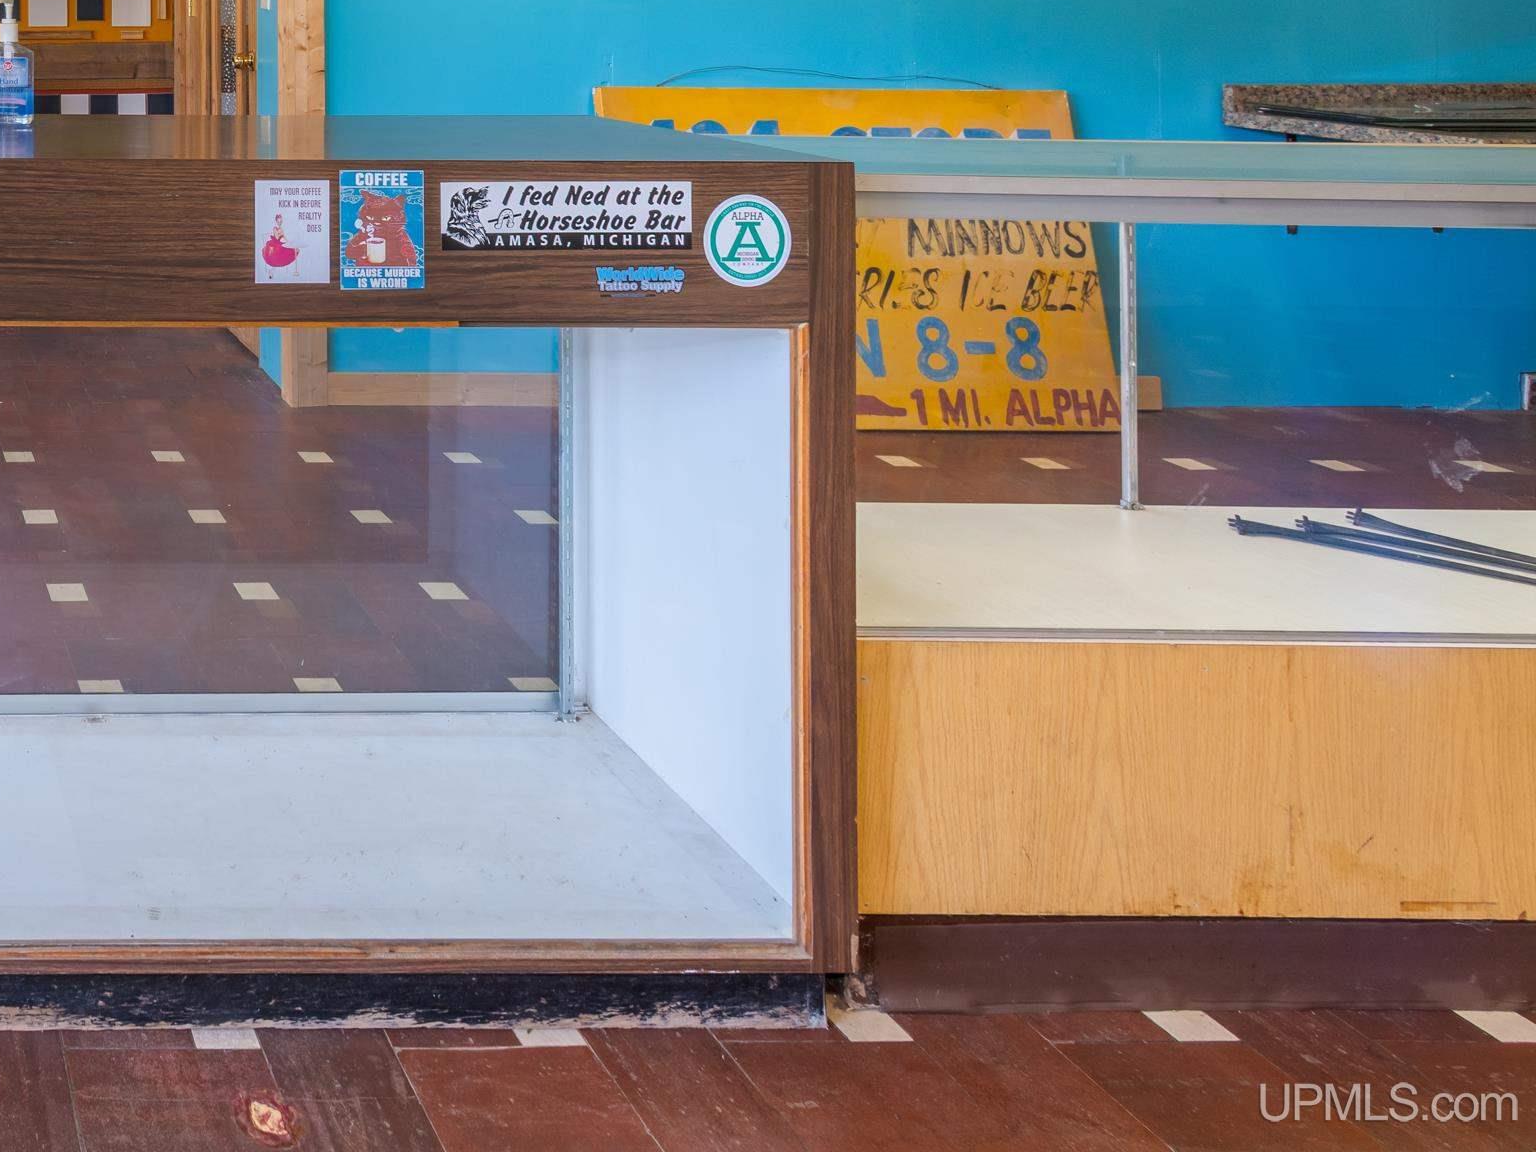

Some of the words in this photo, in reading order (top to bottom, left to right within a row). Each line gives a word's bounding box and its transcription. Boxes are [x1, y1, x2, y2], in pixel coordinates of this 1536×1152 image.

[355, 172, 408, 186] COFFEE
[269, 188, 282, 196] MAY
[284, 188, 300, 196] YOUR
[301, 188, 321, 196] COFFEE
[502, 185, 514, 205] I
[519, 185, 559, 206] fed
[564, 185, 610, 206] Ned
[616, 188, 641, 206] at
[648, 184, 685, 206] the
[279, 200, 291, 208] KICK
[293, 200, 298, 208] IN
[300, 200, 321, 208] BEFORE
[299, 212, 322, 220] REALITY
[519, 210, 636, 231] Horseshoe
[645, 210, 686, 231] Bar
[731, 211, 764, 221] ALPHA
[307, 224, 322, 233] DOES
[494, 235, 572, 247] AMASA,
[583, 234, 685, 246] MICHIGAN
[907, 218, 1087, 259] MINNOWS
[344, 269, 383, 277] BECAUSE
[385, 269, 420, 277] MURDER
[596, 266, 685, 282] WorldWide
[357, 278, 367, 288] IS
[370, 278, 408, 288] WRONG
[597, 281, 638, 291] Tattoo
[640, 280, 683, 293] Supply
[1021, 268, 1098, 312] BEER
[916, 316, 1048, 382] 8-8
[910, 388, 928, 425] 1
[938, 388, 992, 428] MI.
[1006, 388, 1122, 426] ALPHA
